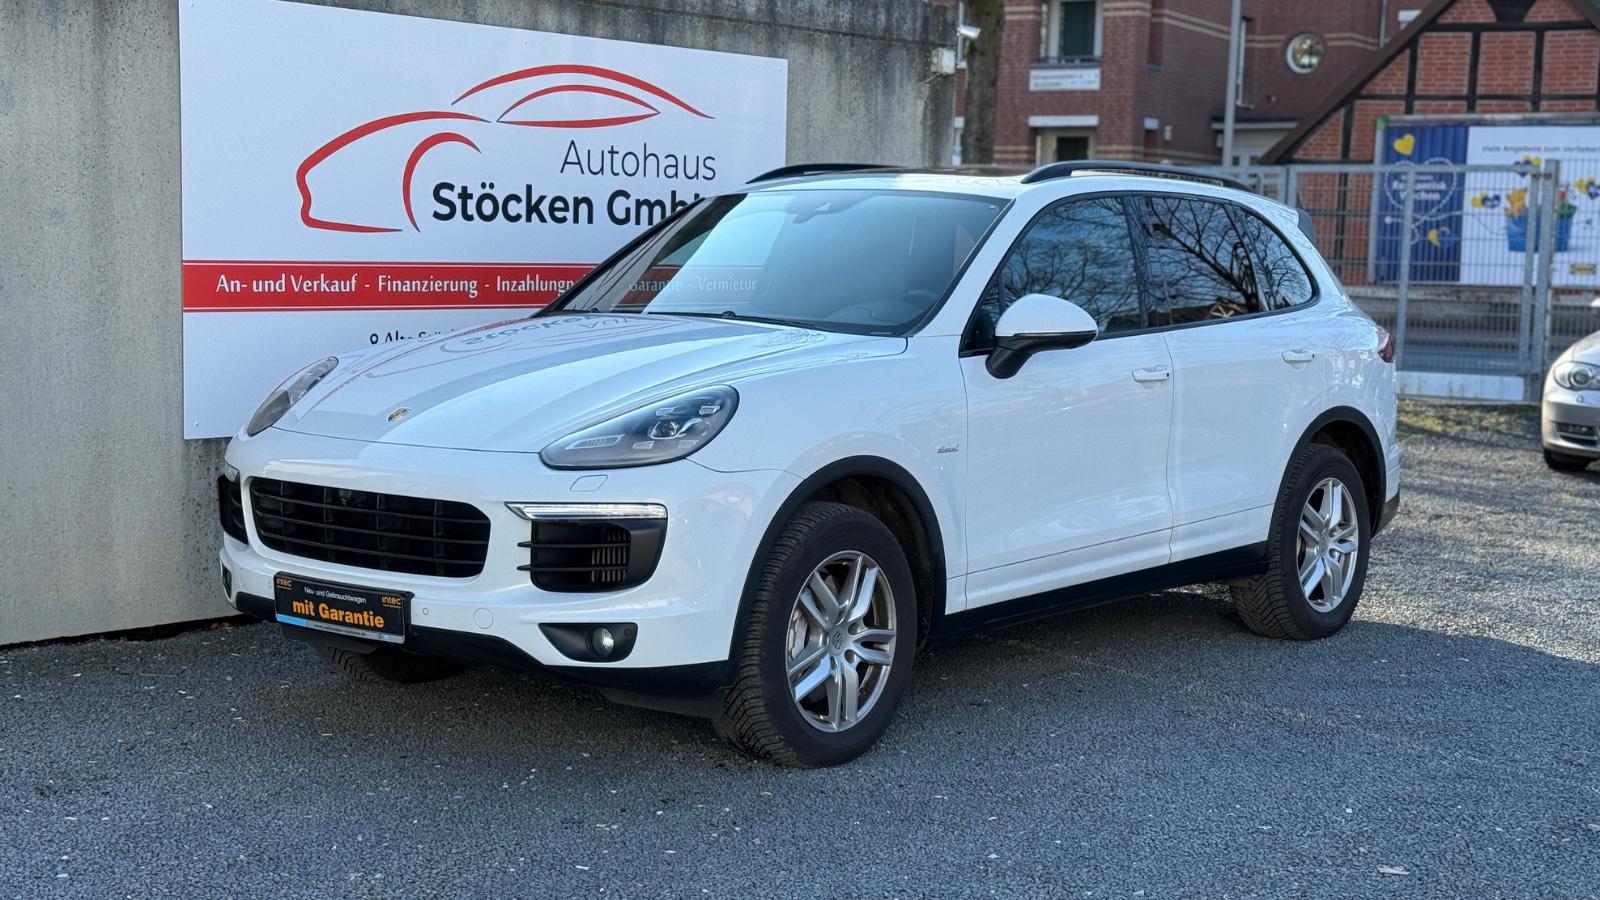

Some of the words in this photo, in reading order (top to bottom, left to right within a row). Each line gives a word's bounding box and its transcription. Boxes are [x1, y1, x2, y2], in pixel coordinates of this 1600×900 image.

[560, 140, 716, 181] Autohaus
[432, 181, 594, 224] Stöcken
[606, 189, 706, 226] Gmb
[216, 274, 247, 293] An-
[252, 274, 286, 293] und
[290, 274, 357, 294] Verkauf
[378, 275, 478, 298] Finanzierung
[292, 599, 316, 617] mit
[318, 602, 385, 629] Garantie
[381, 596, 402, 606] intec
